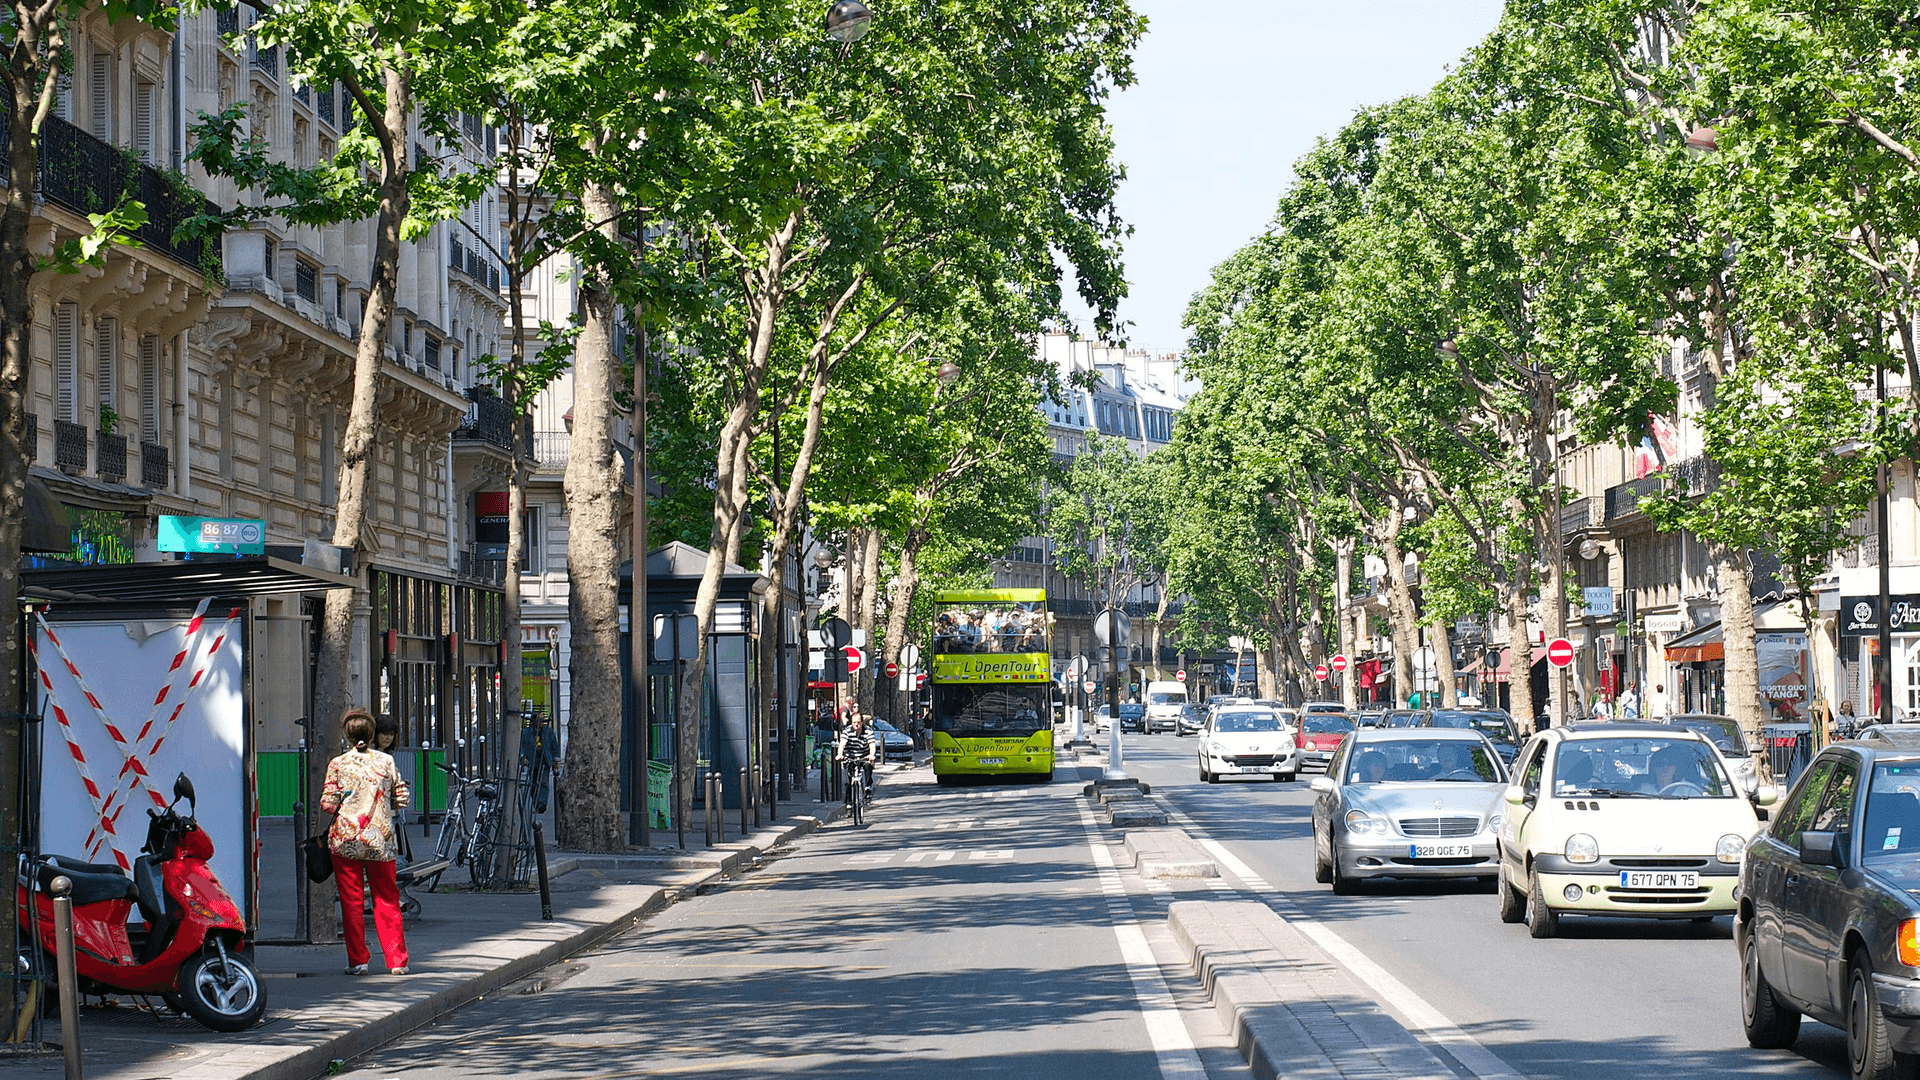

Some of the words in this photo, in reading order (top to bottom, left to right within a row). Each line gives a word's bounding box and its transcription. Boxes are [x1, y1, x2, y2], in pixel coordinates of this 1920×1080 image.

[204, 524, 220, 534] 86
[223, 525, 239, 535] 87
[1594, 603, 1609, 611] BIO
[1416, 846, 1435, 856] 328
[1457, 846, 1470, 855] 75
[1631, 873, 1652, 886] 677
[1656, 874, 1677, 886] QPN
[1681, 874, 1695, 886] 75
